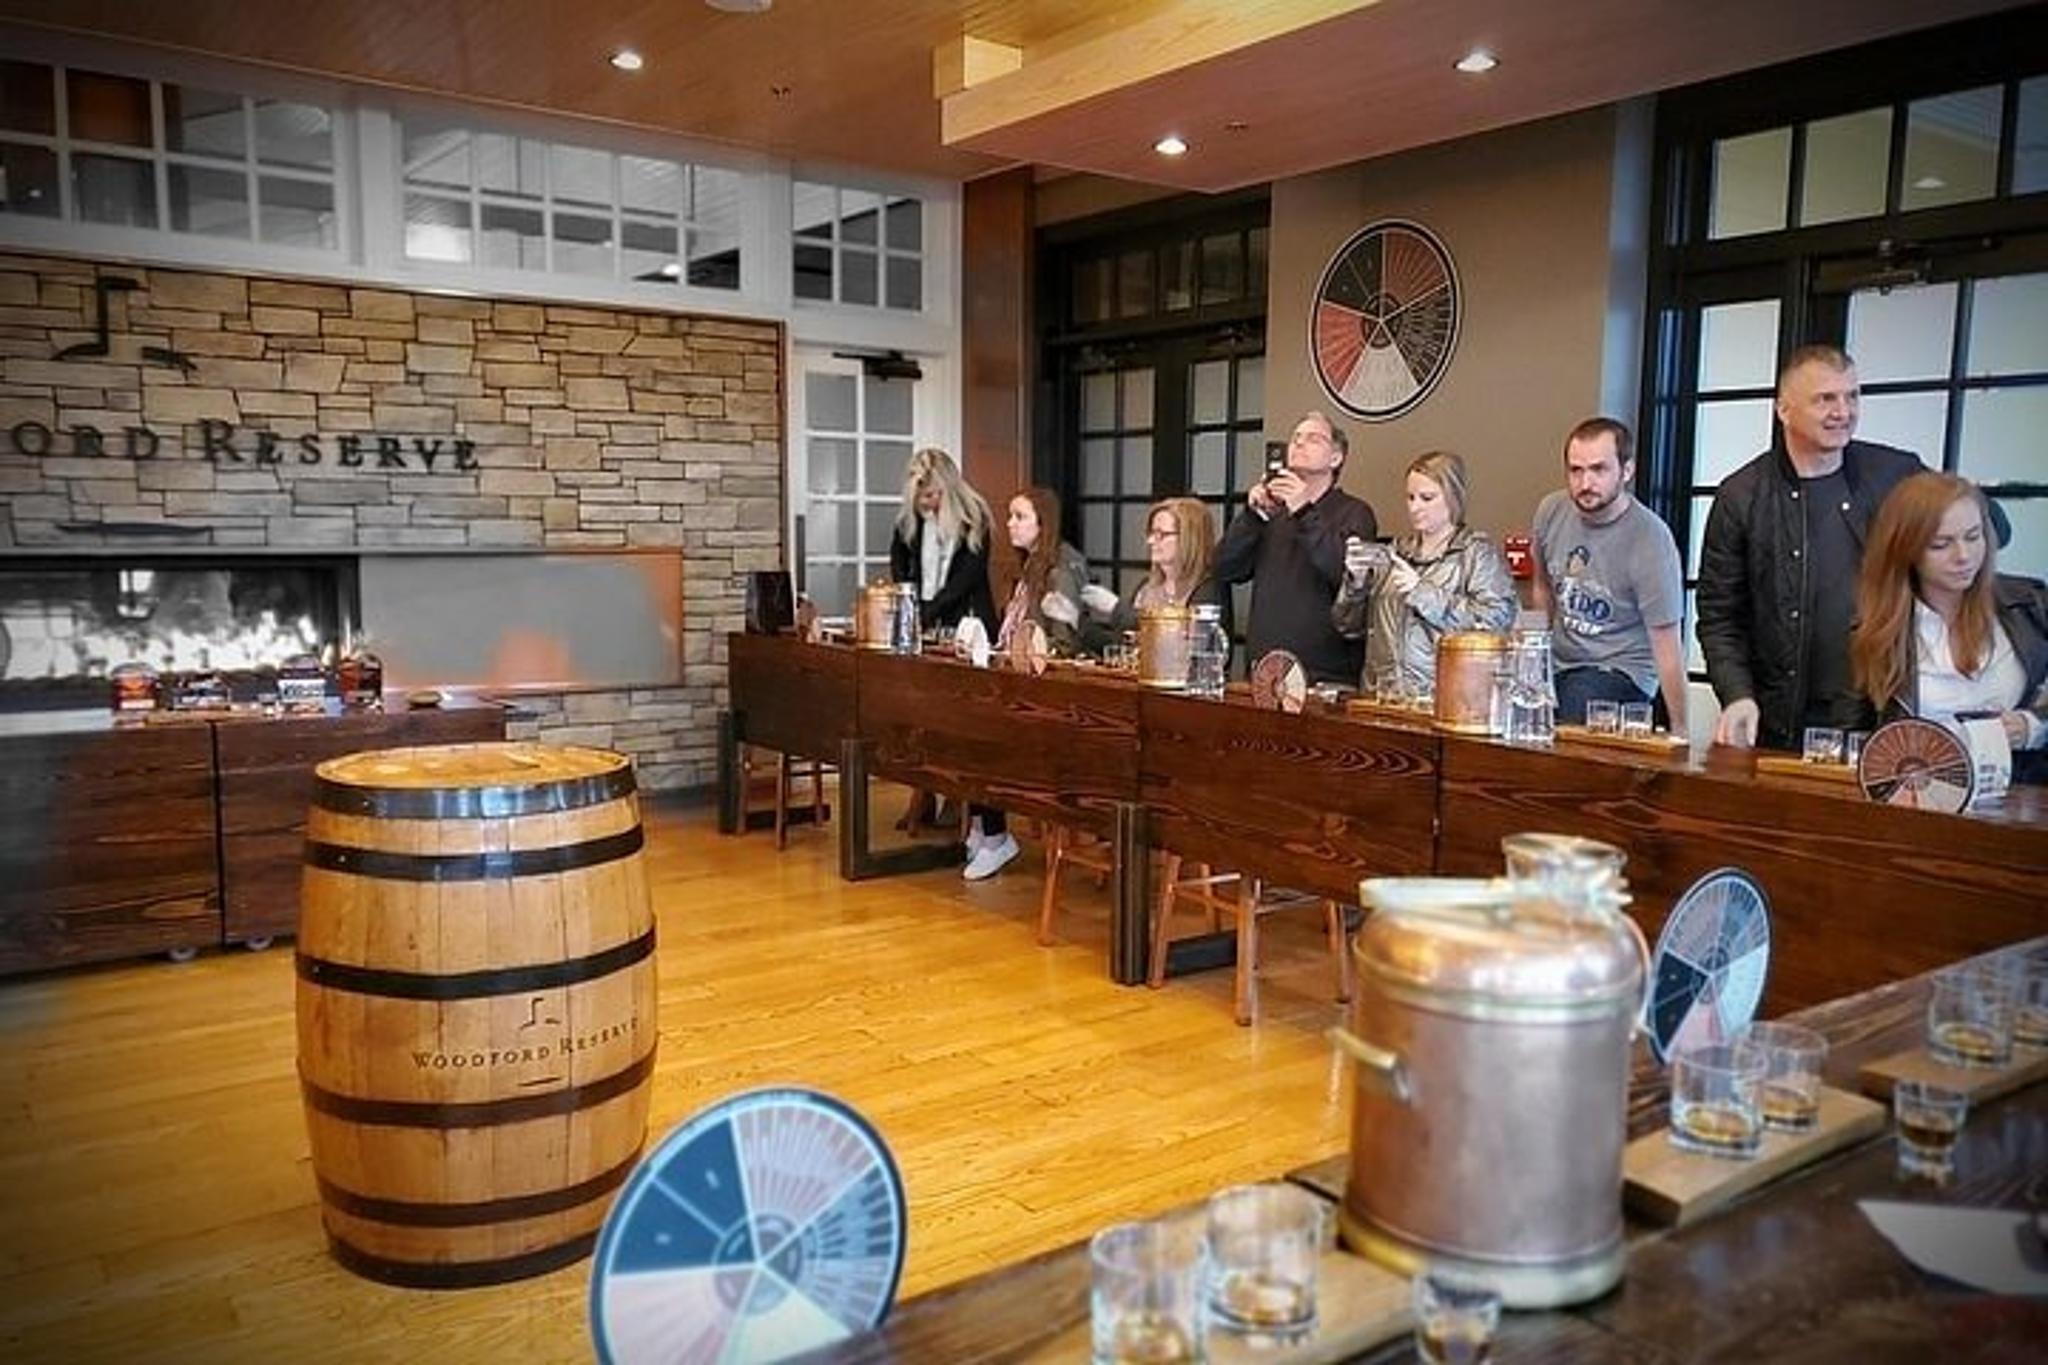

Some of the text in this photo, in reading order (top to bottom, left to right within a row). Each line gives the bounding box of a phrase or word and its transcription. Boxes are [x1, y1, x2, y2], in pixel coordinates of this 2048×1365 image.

[12, 418, 479, 474] ORD RESERVE
[412, 1016, 638, 1070] WOODFORD RESERVE
